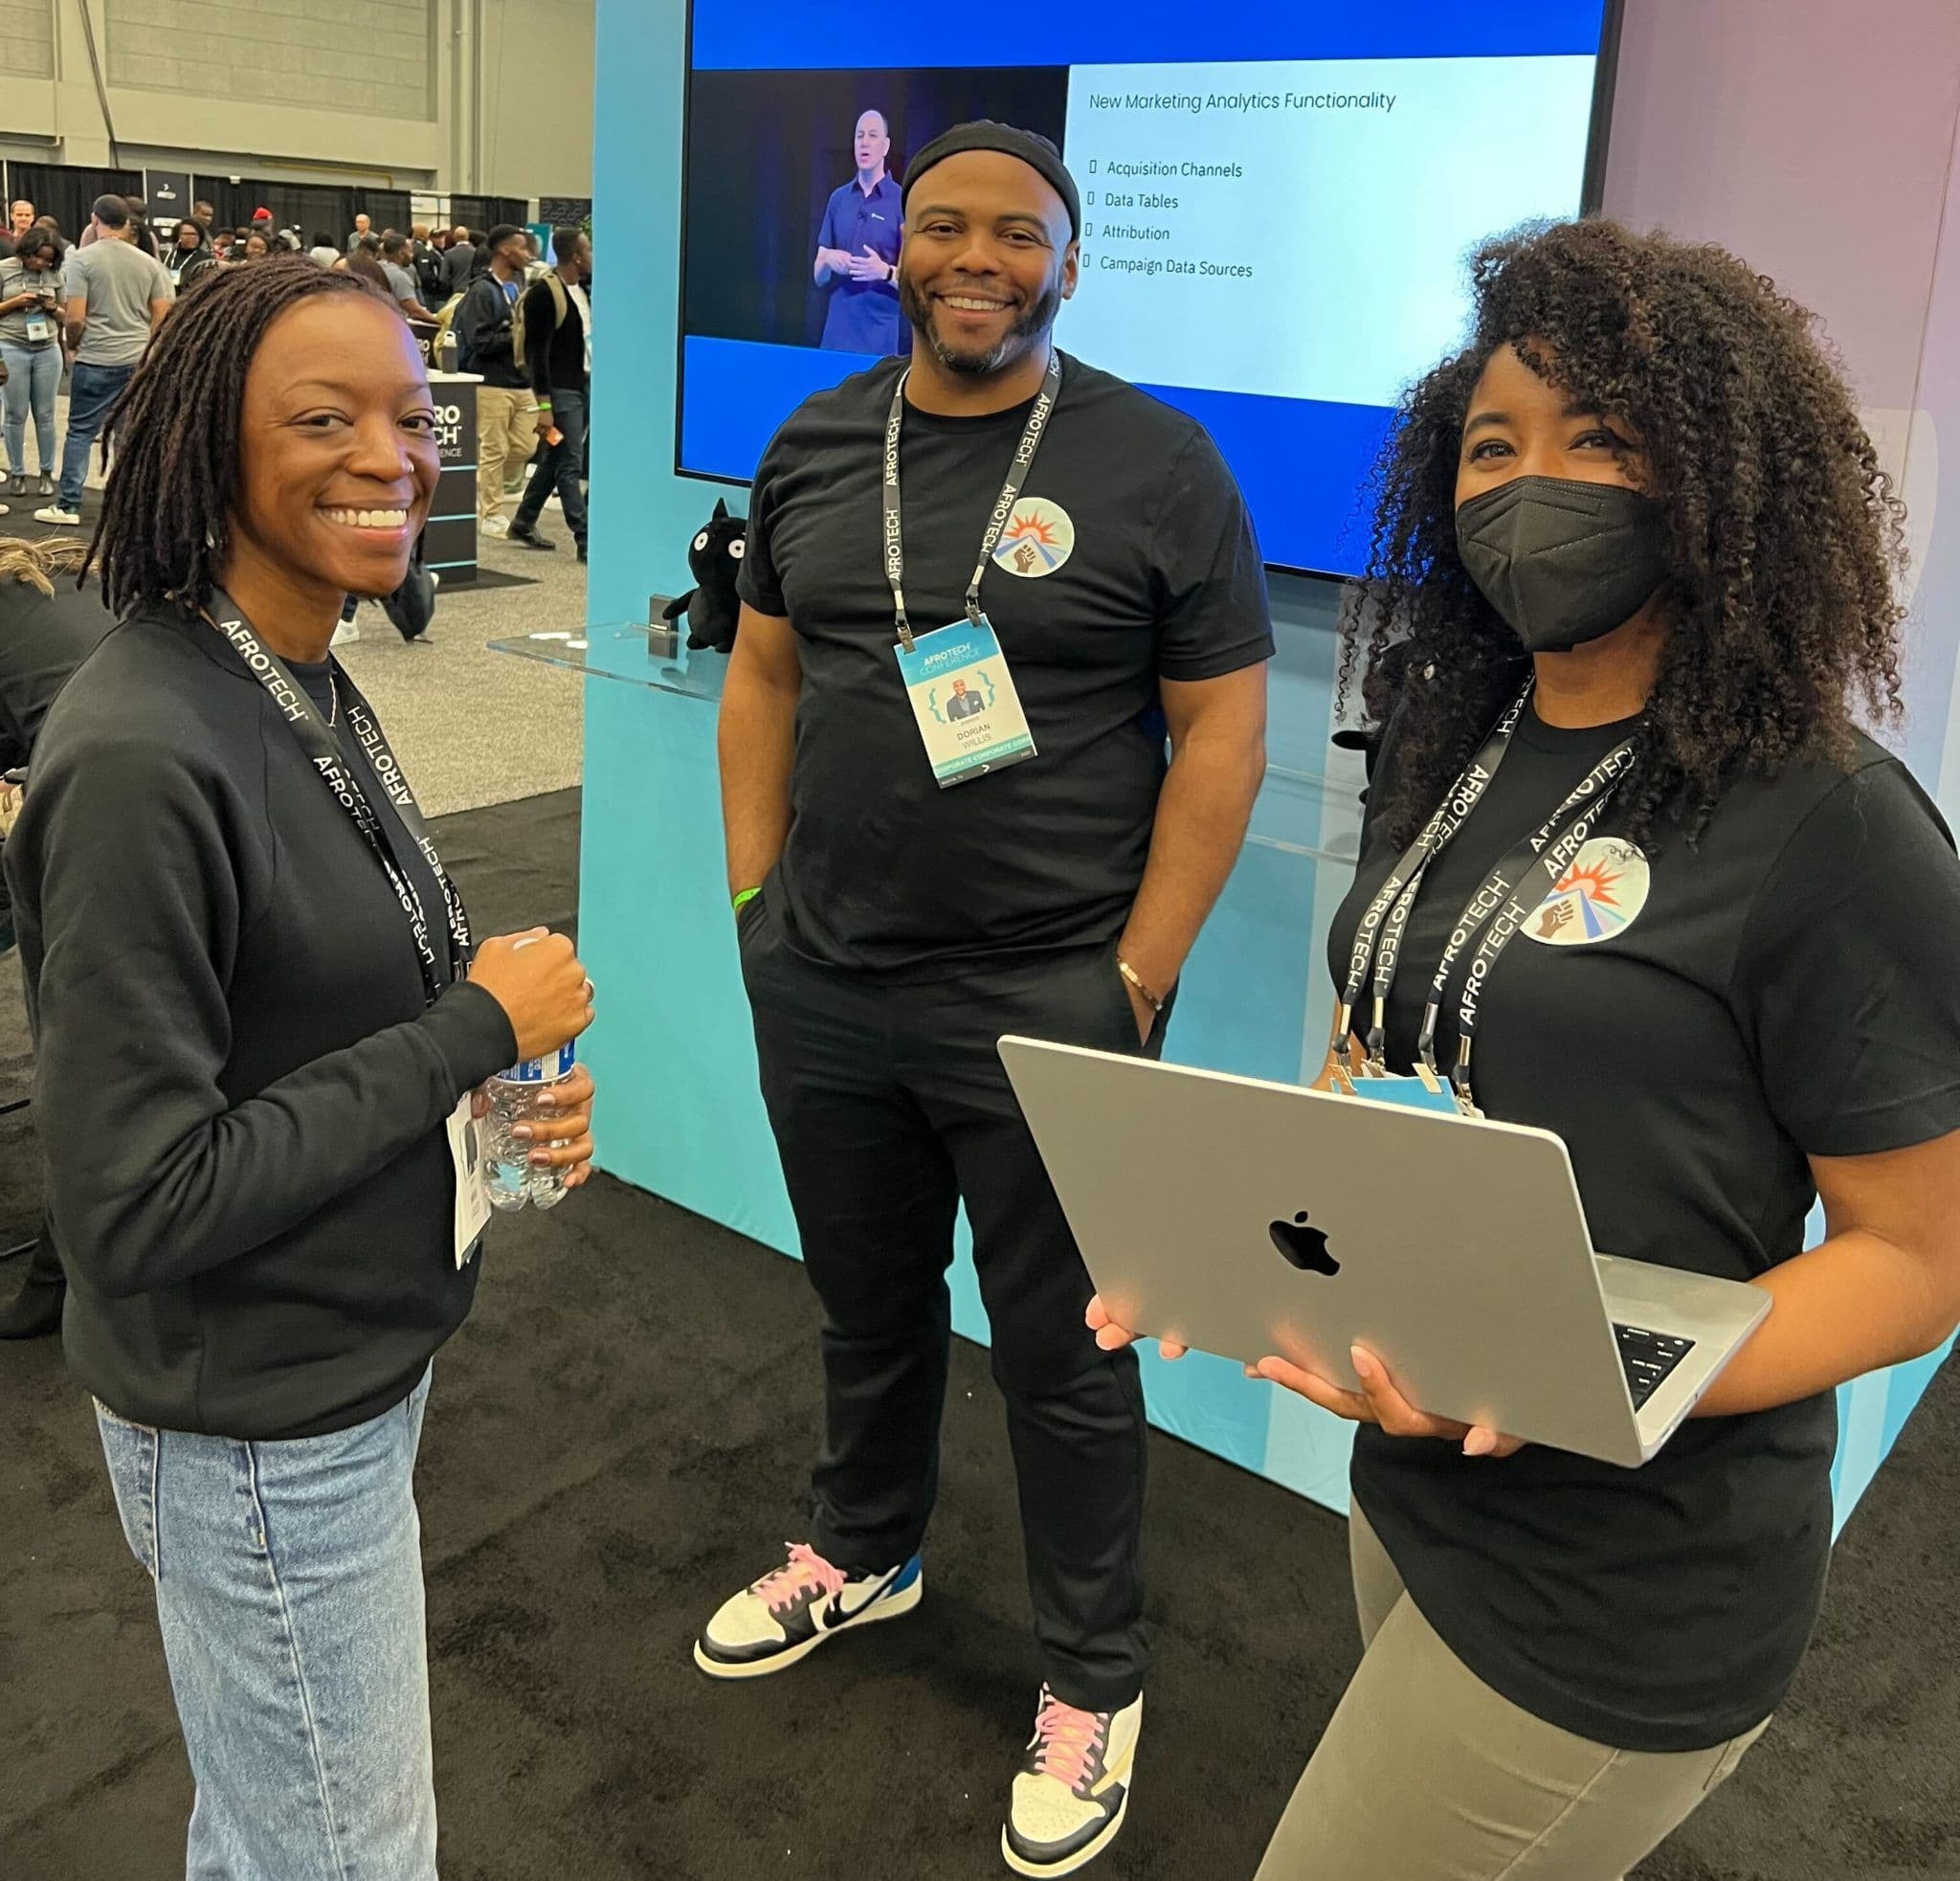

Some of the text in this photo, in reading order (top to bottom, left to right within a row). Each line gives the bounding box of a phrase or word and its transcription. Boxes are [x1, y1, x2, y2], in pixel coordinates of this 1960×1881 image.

[1089, 92, 1396, 114] New Marketing Analytics Functionality
[1107, 161, 1242, 177] Acquisition Channels
[1105, 192, 1178, 208] Data Tables
[1102, 225, 1169, 239] Attribution
[1101, 257, 1253, 277] Campaign Data Sources
[433, 426, 457, 445] CH
[434, 405, 460, 424] RO
[1015, 392, 1051, 466] AFROTECH
[886, 417, 902, 486] AFROTECH
[981, 484, 1017, 555] AFROTECH
[886, 507, 903, 580] AFROTECH
[220, 619, 306, 722] AFROTECH
[924, 642, 971, 666] AFROTECH
[957, 723, 991, 741] DORIAN
[347, 705, 412, 806] AFROTECH
[1348, 876, 1402, 990] AFROTECH
[1433, 871, 1510, 992] AFROTECH
[1459, 898, 1526, 1026] AFROTECH
